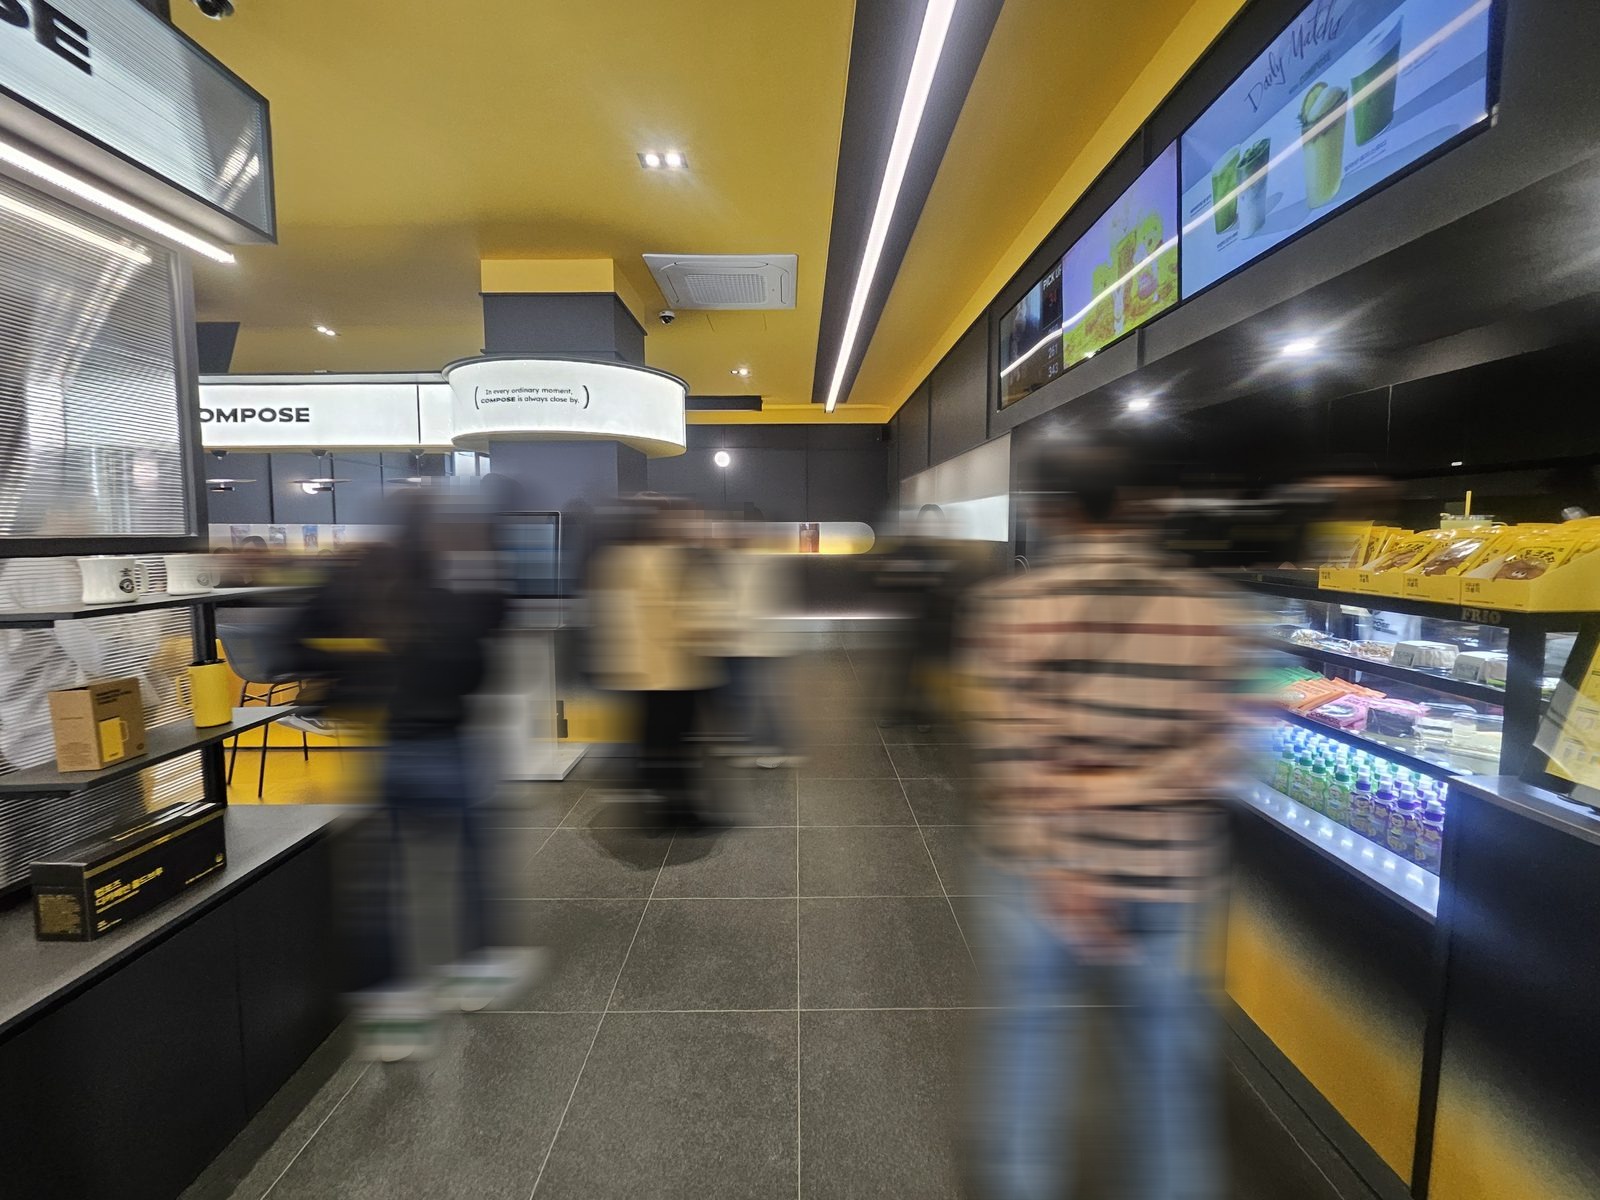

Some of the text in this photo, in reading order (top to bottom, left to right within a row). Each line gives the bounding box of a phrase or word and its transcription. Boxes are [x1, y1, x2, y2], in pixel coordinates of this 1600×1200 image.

[0, 0, 92, 76] E
[1244, 52, 1286, 113] Daily
[480, 396, 516, 404] COMPOSE
[524, 395, 549, 403] always
[550, 395, 568, 403] close
[1462, 607, 1501, 624] FRIO
